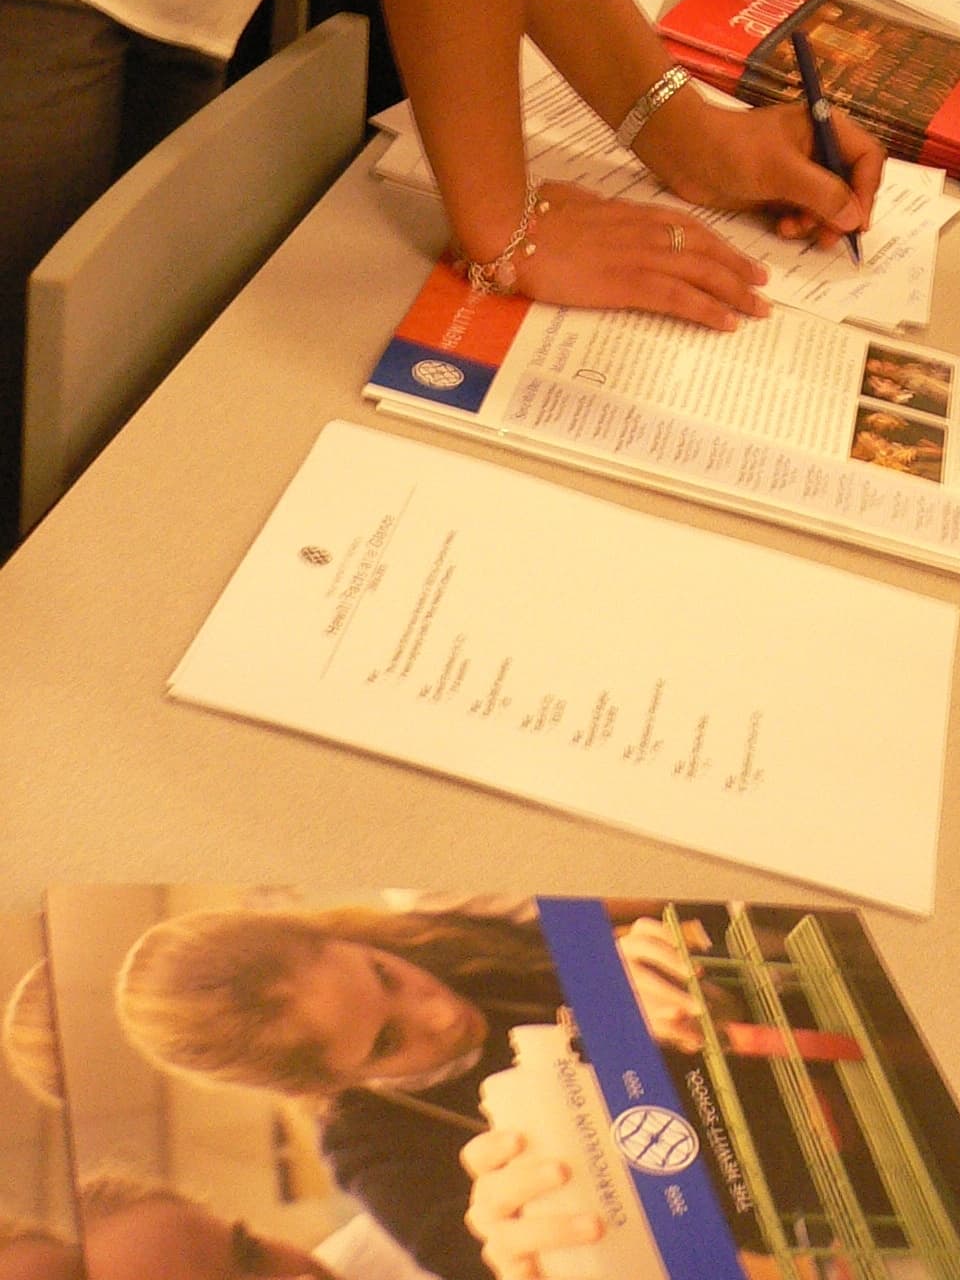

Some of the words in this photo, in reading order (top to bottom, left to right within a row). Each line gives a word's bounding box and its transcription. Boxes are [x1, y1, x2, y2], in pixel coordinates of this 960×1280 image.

[556, 1058, 586, 1108] GUIDE
[685, 1068, 718, 1126] SCHOOL
[575, 1114, 627, 1227] CURRICULUM
[707, 1126, 743, 1184] HEWITT
[728, 1184, 752, 1213] THE
